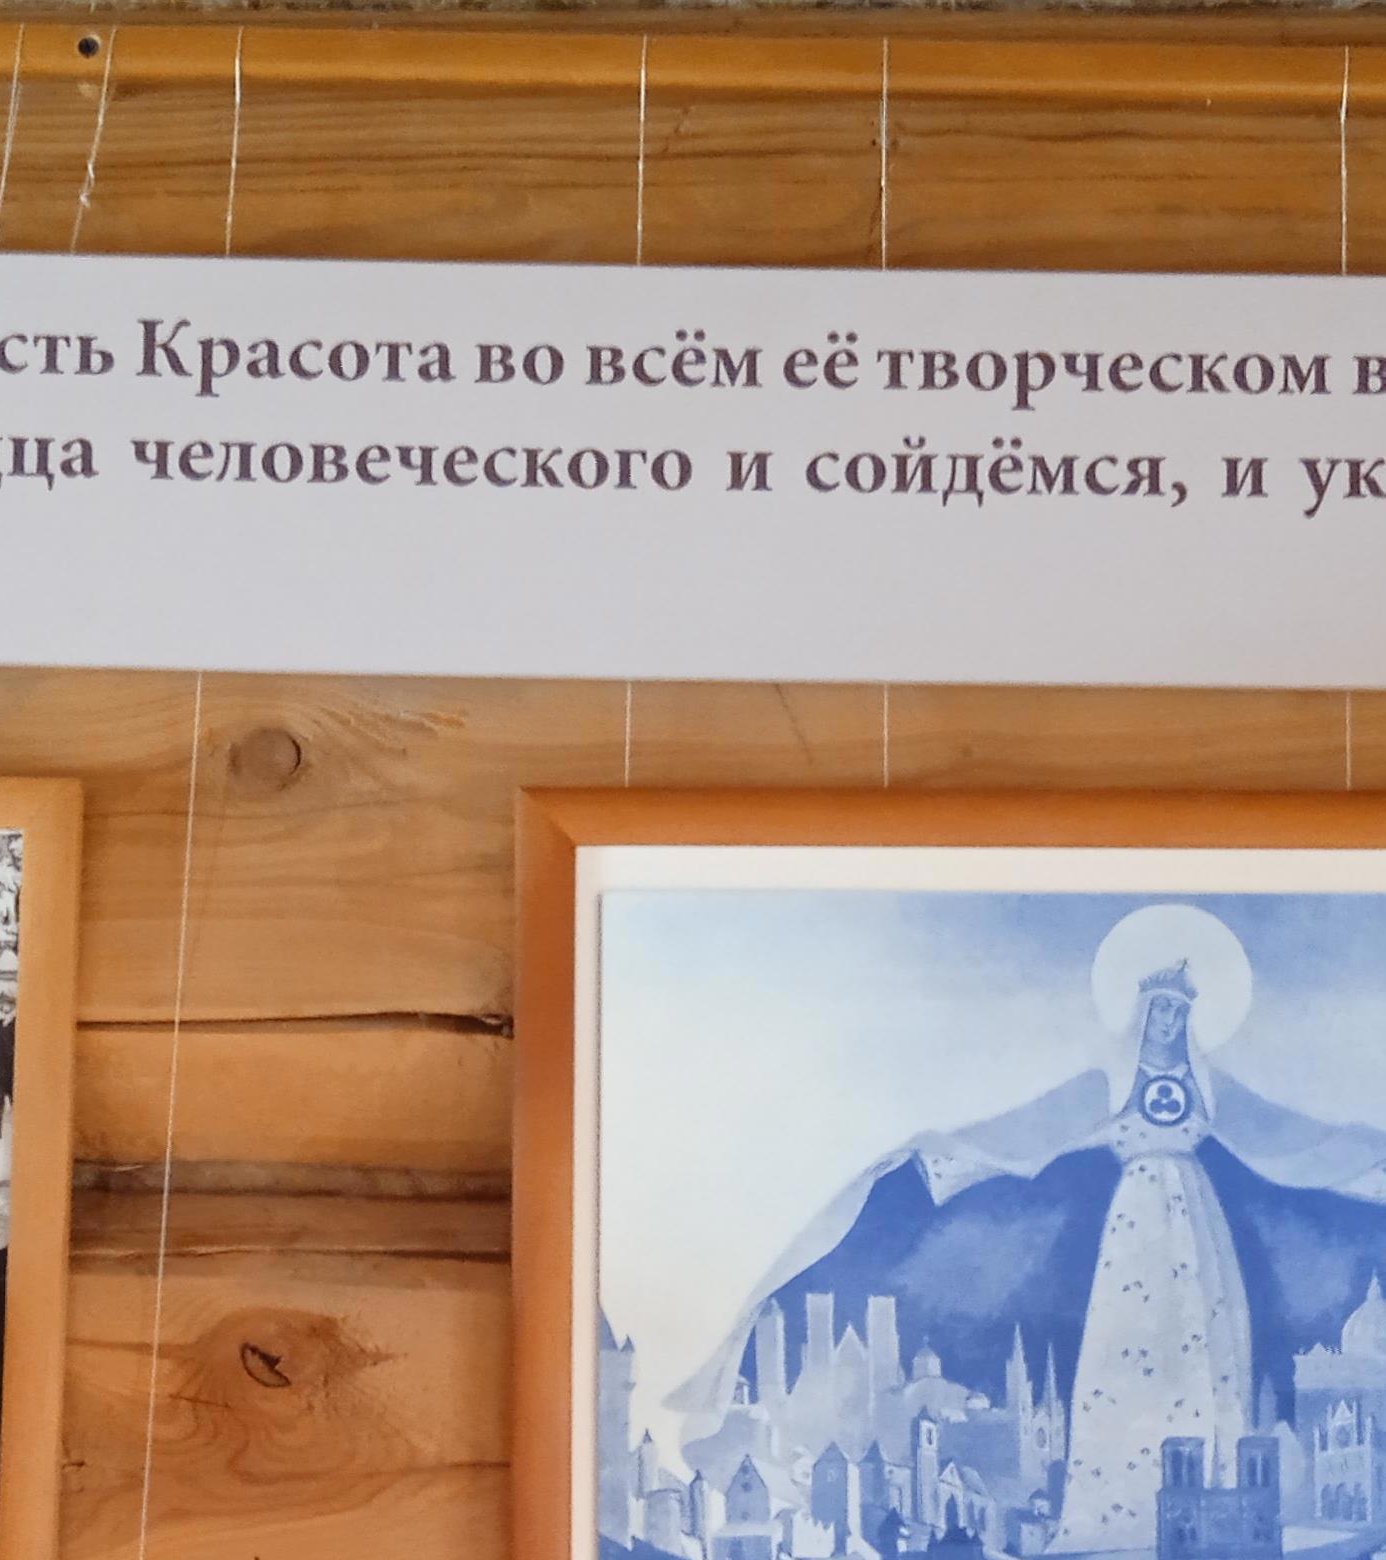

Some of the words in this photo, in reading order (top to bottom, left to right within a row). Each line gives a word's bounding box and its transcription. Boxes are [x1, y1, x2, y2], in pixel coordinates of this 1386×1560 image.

[136, 319, 456, 397] Красота
[474, 344, 564, 386] во
[585, 329, 762, 388] всём
[783, 331, 859, 390] её
[877, 350, 1331, 411] творческом
[130, 440, 692, 491] человеческого
[726, 451, 773, 491] и
[805, 435, 1187, 507] сойдёмся,
[1221, 457, 1268, 498] и
